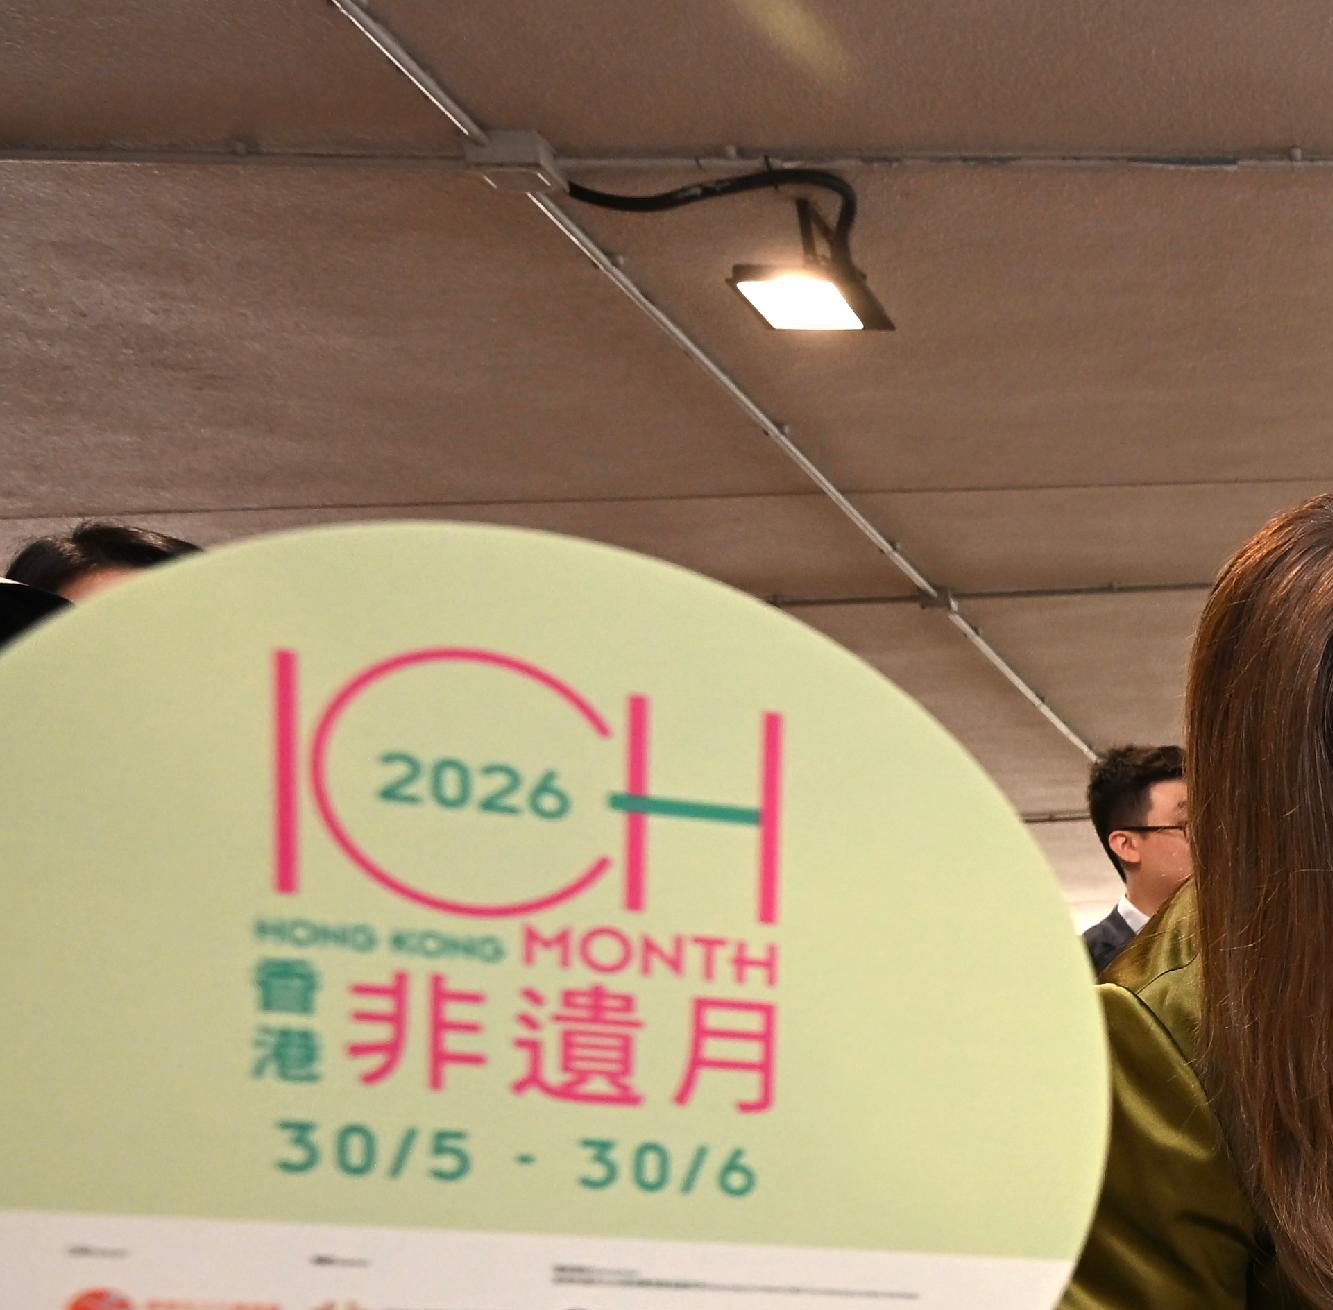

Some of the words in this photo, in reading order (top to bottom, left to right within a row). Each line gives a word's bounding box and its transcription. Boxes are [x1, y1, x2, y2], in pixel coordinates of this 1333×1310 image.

[274, 647, 784, 926] ICH
[376, 750, 572, 820] 2026
[252, 918, 378, 953] HONG
[390, 927, 505, 964] KONG
[521, 924, 780, 987] MONTH
[251, 957, 321, 1083] 香港
[344, 969, 779, 1114] 非遺月
[275, 1118, 473, 1182] 30/5
[576, 1137, 758, 1198] 30/6
